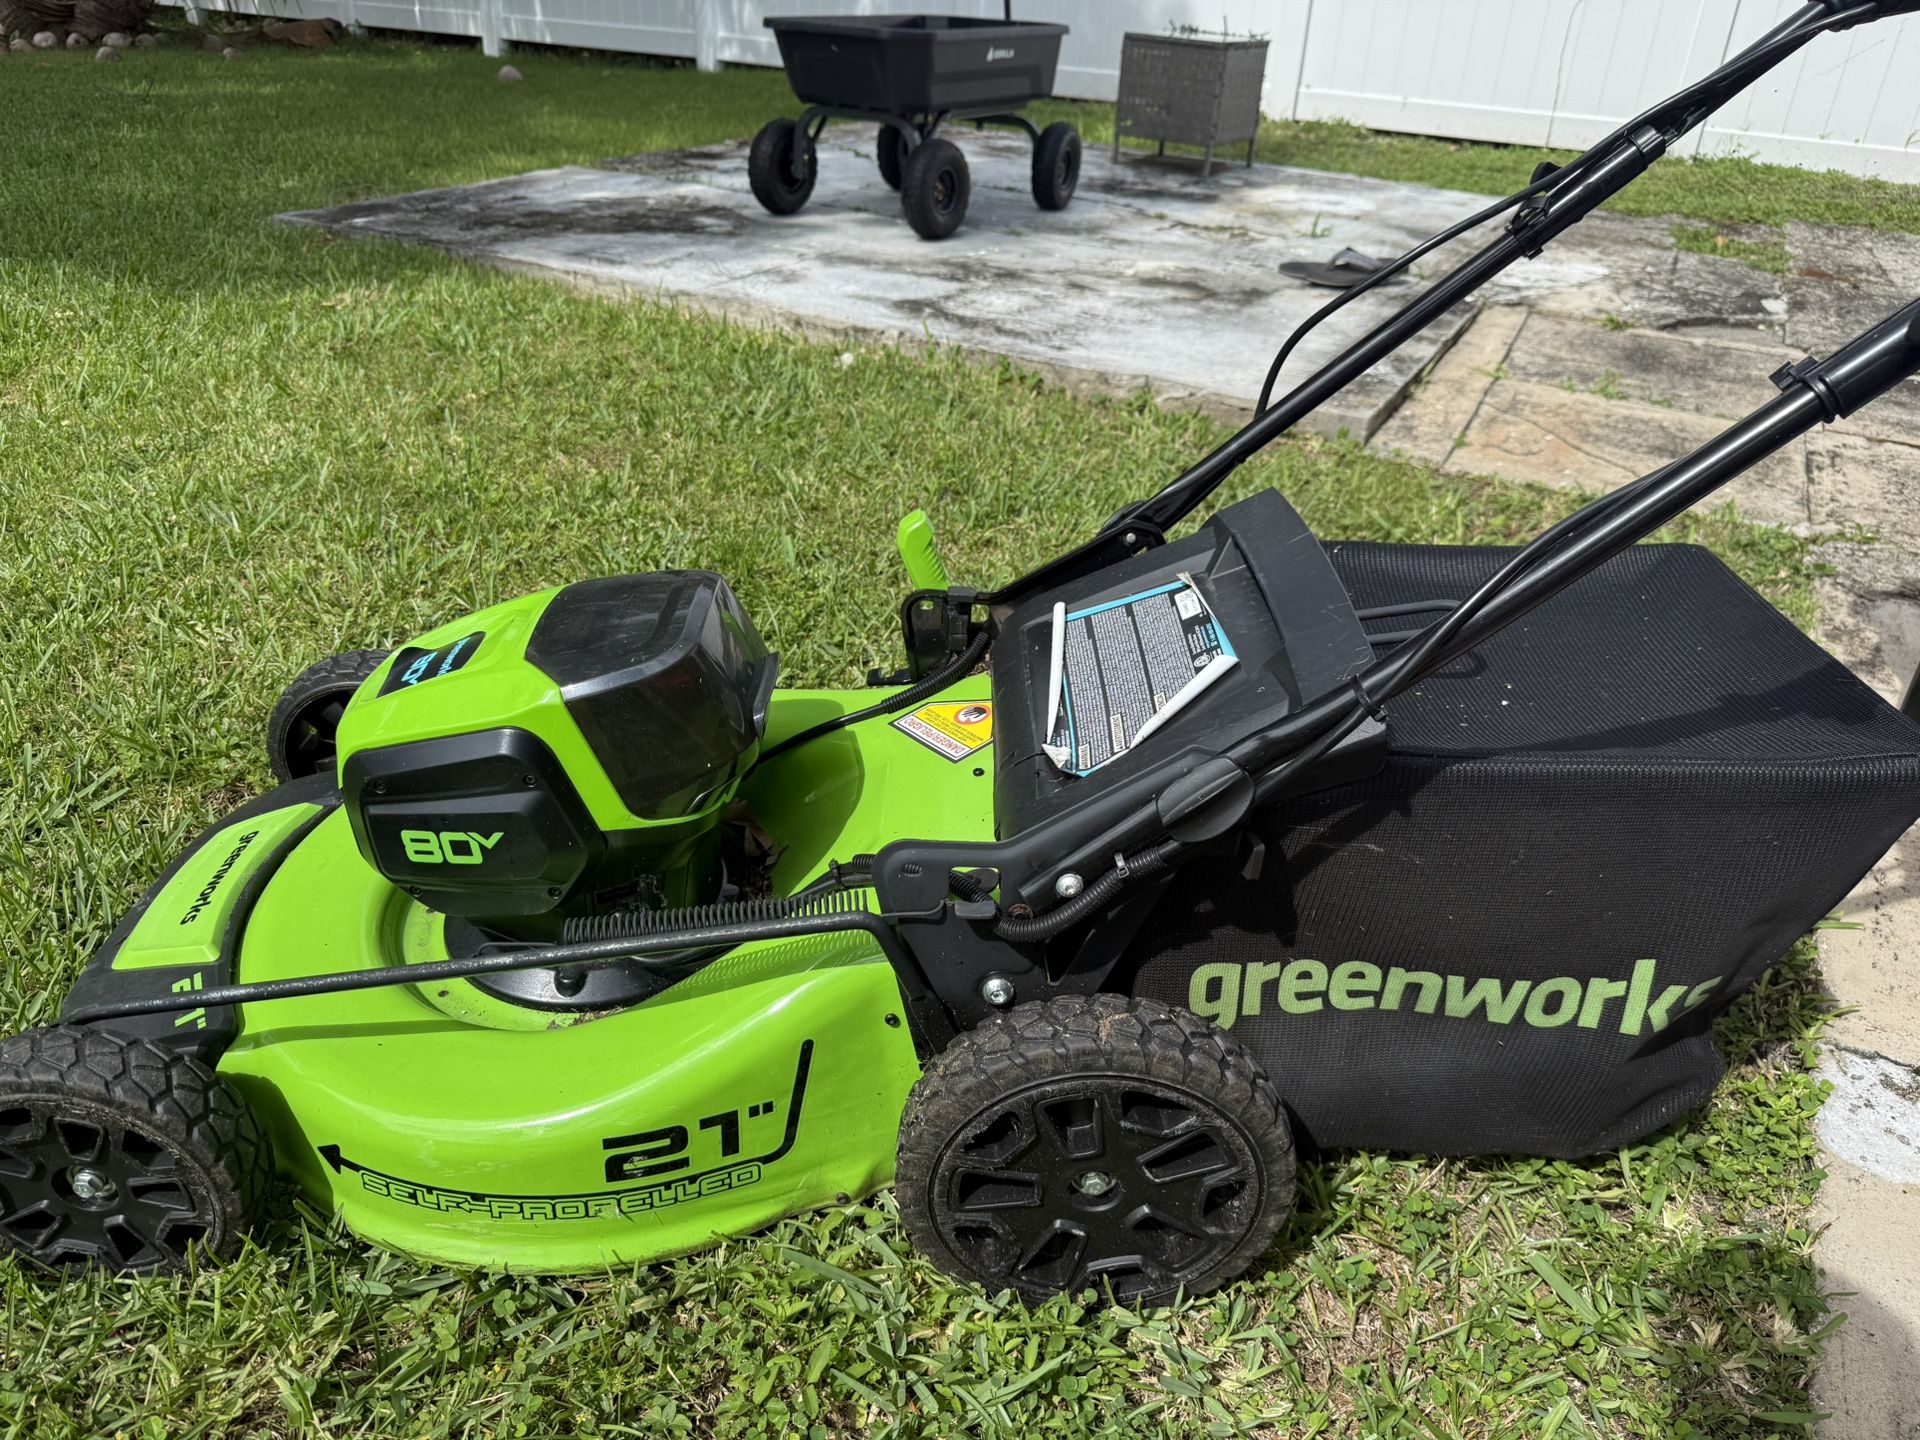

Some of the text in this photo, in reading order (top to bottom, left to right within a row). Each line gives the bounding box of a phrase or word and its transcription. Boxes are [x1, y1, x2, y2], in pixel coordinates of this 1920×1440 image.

[179, 829, 260, 926] greenworks
[401, 829, 505, 864] 80V
[602, 1100, 774, 1183] 21"
